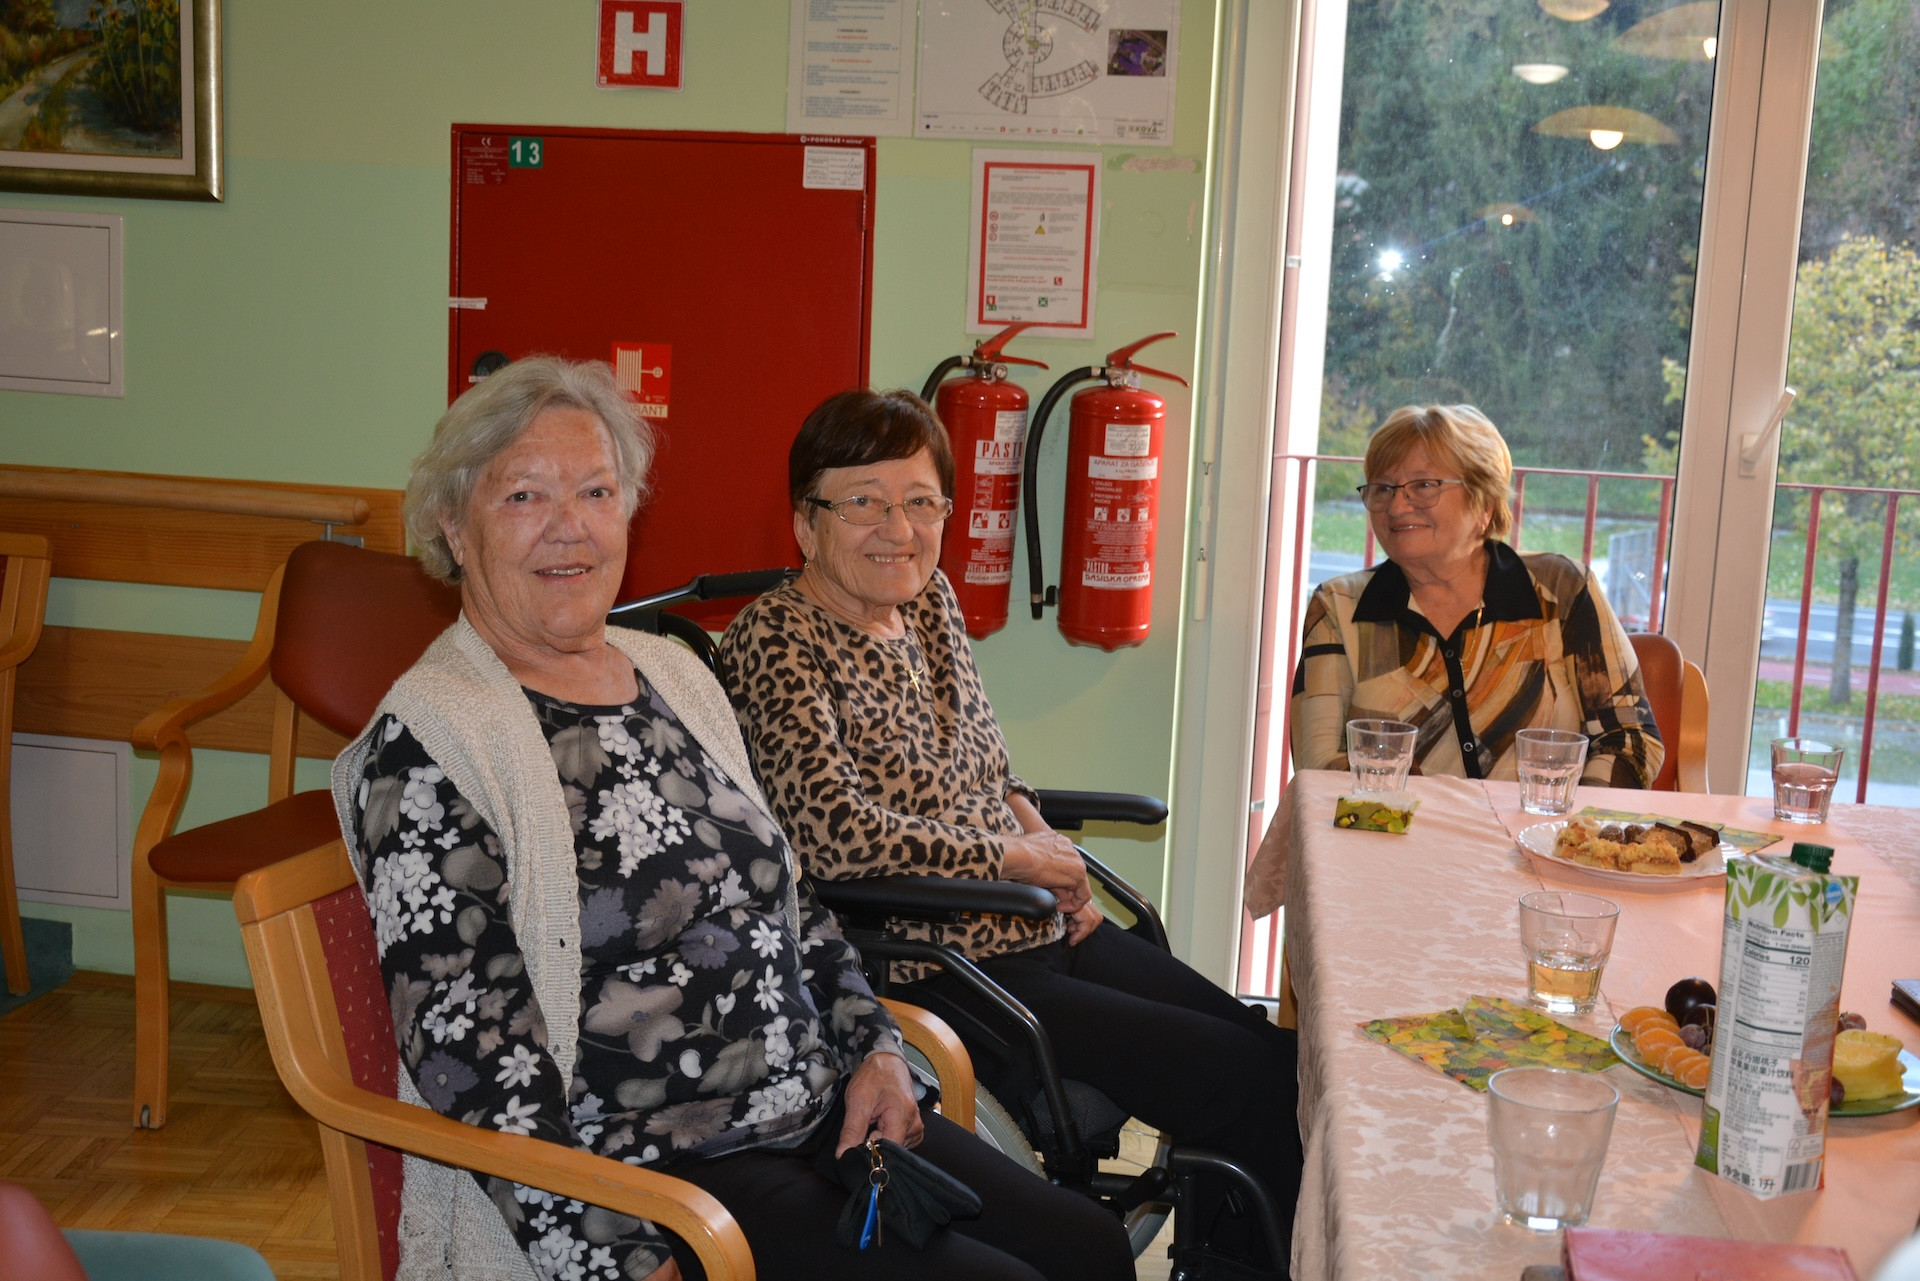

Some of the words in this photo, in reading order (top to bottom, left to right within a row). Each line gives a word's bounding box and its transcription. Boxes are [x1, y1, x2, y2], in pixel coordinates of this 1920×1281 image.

[614, 11, 667, 76] H
[511, 140, 540, 165] 13
[1093, 459, 1119, 467] APARAT
[1120, 460, 1129, 468] ZA
[1747, 920, 1778, 936] Nutrition
[1780, 930, 1805, 938] Facts
[1743, 946, 1770, 961] Calories
[1789, 955, 1810, 966] 120
